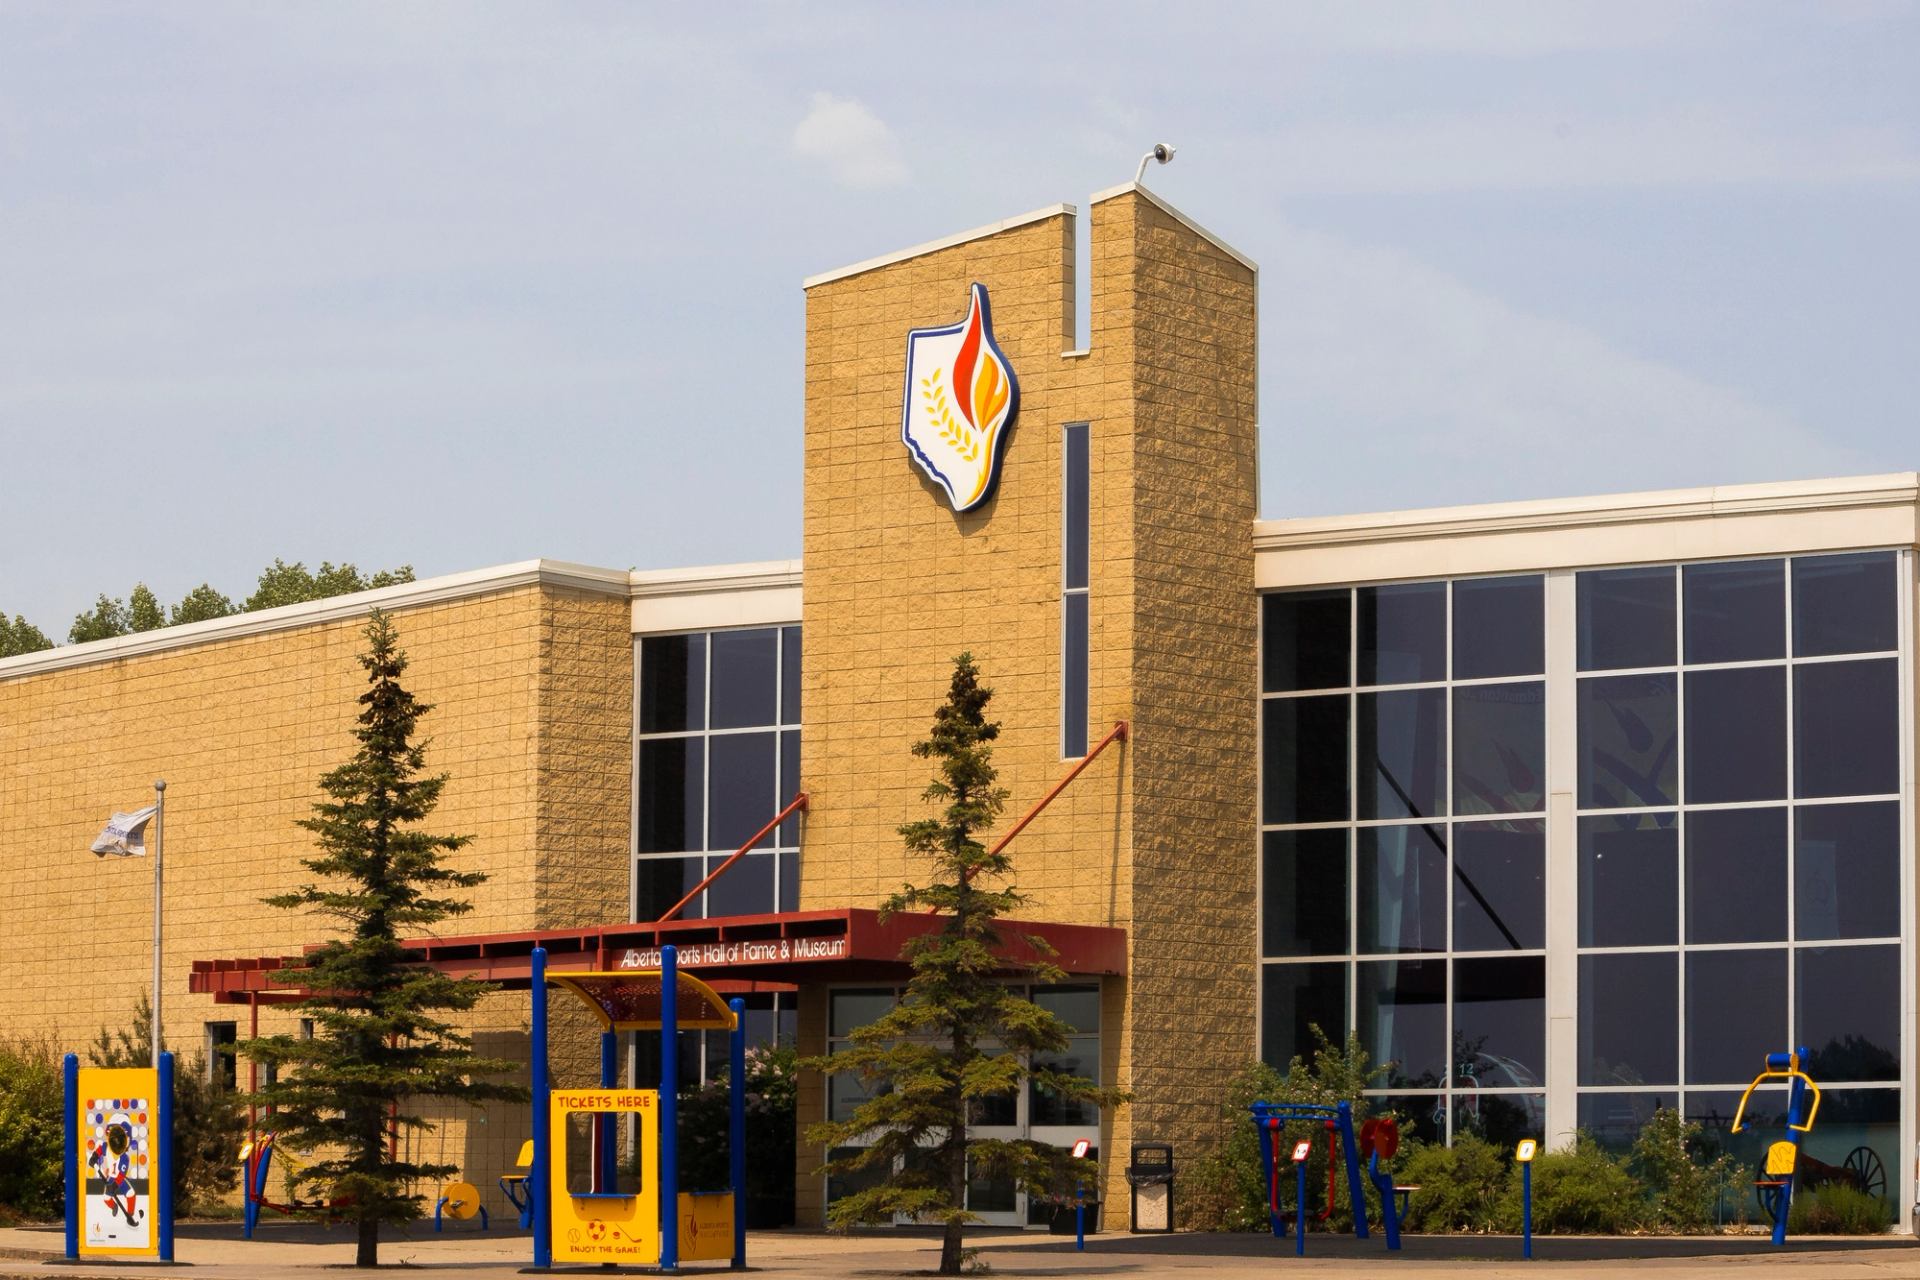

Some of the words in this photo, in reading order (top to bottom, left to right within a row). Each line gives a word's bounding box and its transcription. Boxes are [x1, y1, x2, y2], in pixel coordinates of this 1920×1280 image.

[620, 948, 662, 968] Alberta
[675, 945, 701, 965] orts
[703, 943, 725, 963] Hall
[726, 942, 739, 961] of
[743, 941, 777, 961] Fame
[780, 940, 790, 959] &
[794, 938, 846, 958] Museum
[558, 1096, 612, 1108] TICKETS
[617, 1096, 650, 1107] HERE
[570, 1245, 596, 1253] ENJOY
[599, 1245, 612, 1253] THE
[615, 1246, 641, 1254] GAME!
